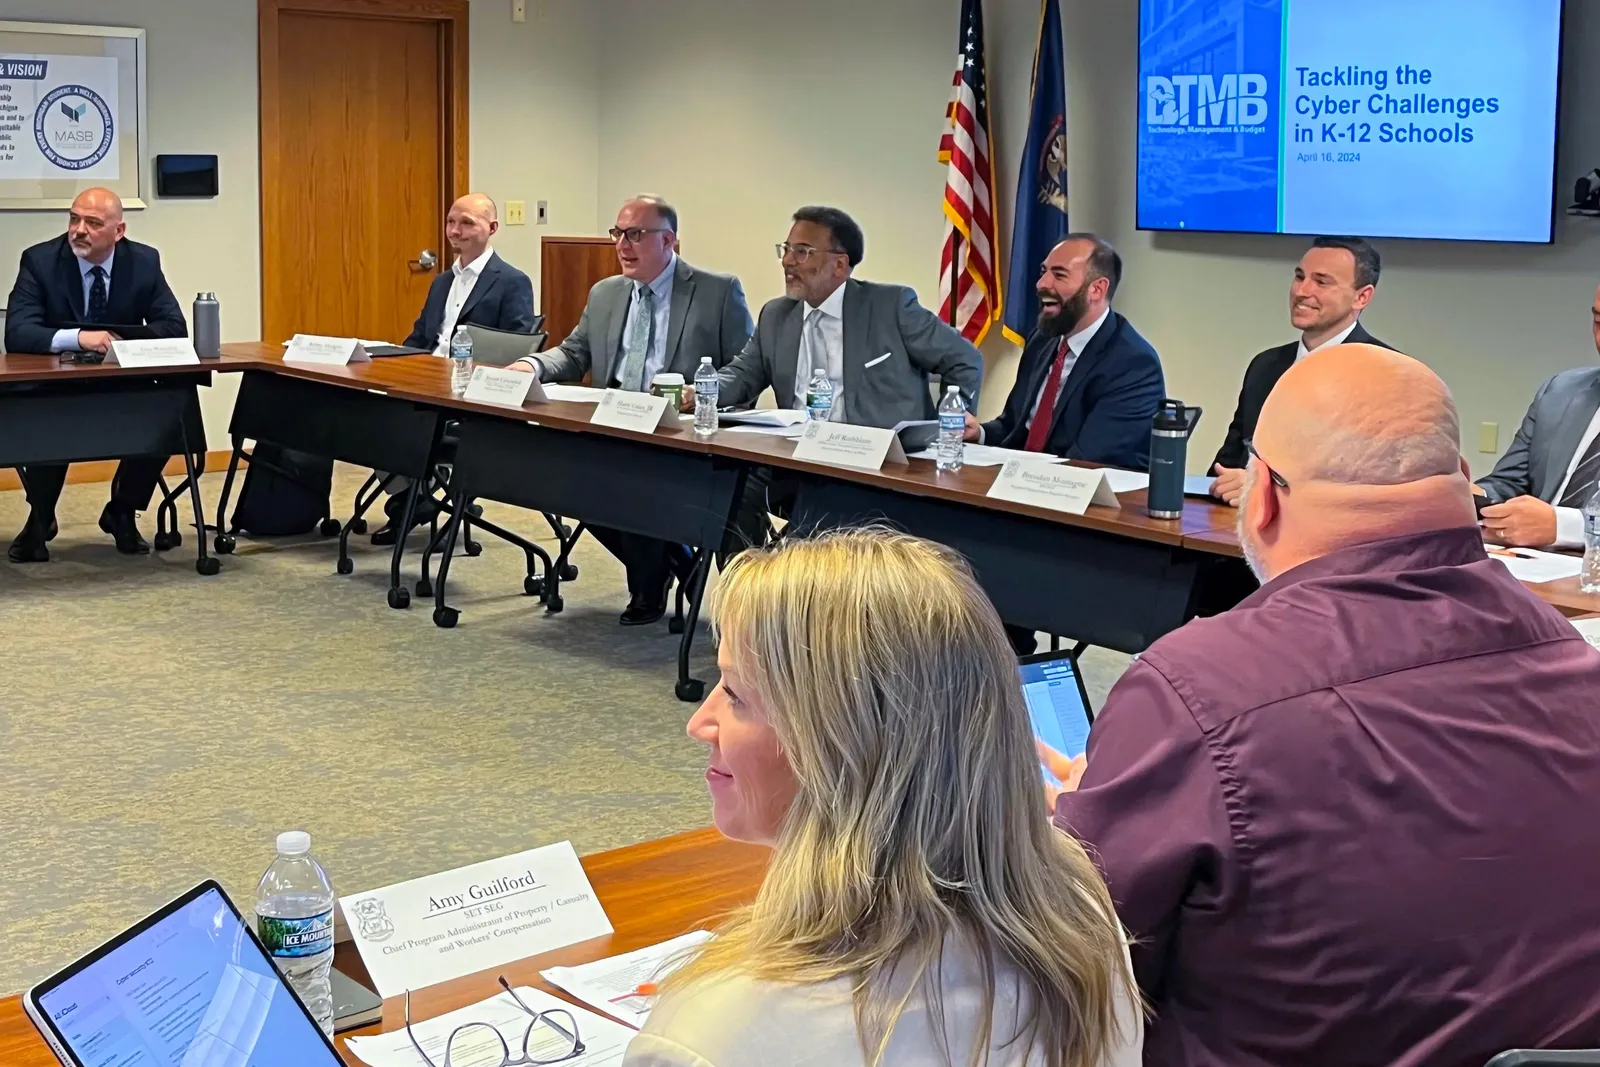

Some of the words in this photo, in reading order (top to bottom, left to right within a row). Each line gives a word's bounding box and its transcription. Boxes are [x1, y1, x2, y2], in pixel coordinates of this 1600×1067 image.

[7, 63, 43, 76] VISION
[1295, 66, 1388, 91] Tackling
[1396, 65, 1432, 85] the
[1147, 73, 1268, 126] DTMB
[1295, 95, 1360, 119] Cyber
[1368, 93, 1500, 119] Challenges
[55, 131, 93, 142] MASB
[1240, 126, 1265, 135] Budget
[1295, 123, 1313, 142] in
[1322, 123, 1371, 142] K-12
[1378, 122, 1474, 143] Schools
[1297, 152, 1318, 163] April
[1321, 153, 1335, 162] 16,
[1337, 152, 1361, 162] 2024
[826, 432, 841, 442] Jeff
[1022, 471, 1051, 481] Brendan
[429, 893, 465, 912] Amy
[469, 870, 536, 900] Guilford
[464, 907, 483, 919] SET
[484, 902, 504, 915] SEG
[382, 941, 408, 955] Chief
[407, 932, 445, 948] Program
[447, 917, 504, 937] Administrator
[504, 912, 514, 921] of
[514, 903, 549, 920] Property
[550, 899, 555, 910] /
[556, 893, 590, 907] Casualty
[286, 935, 299, 946] ICE
[438, 944, 455, 954] and
[455, 932, 492, 948] Workers'
[493, 917, 552, 938] Compensation
